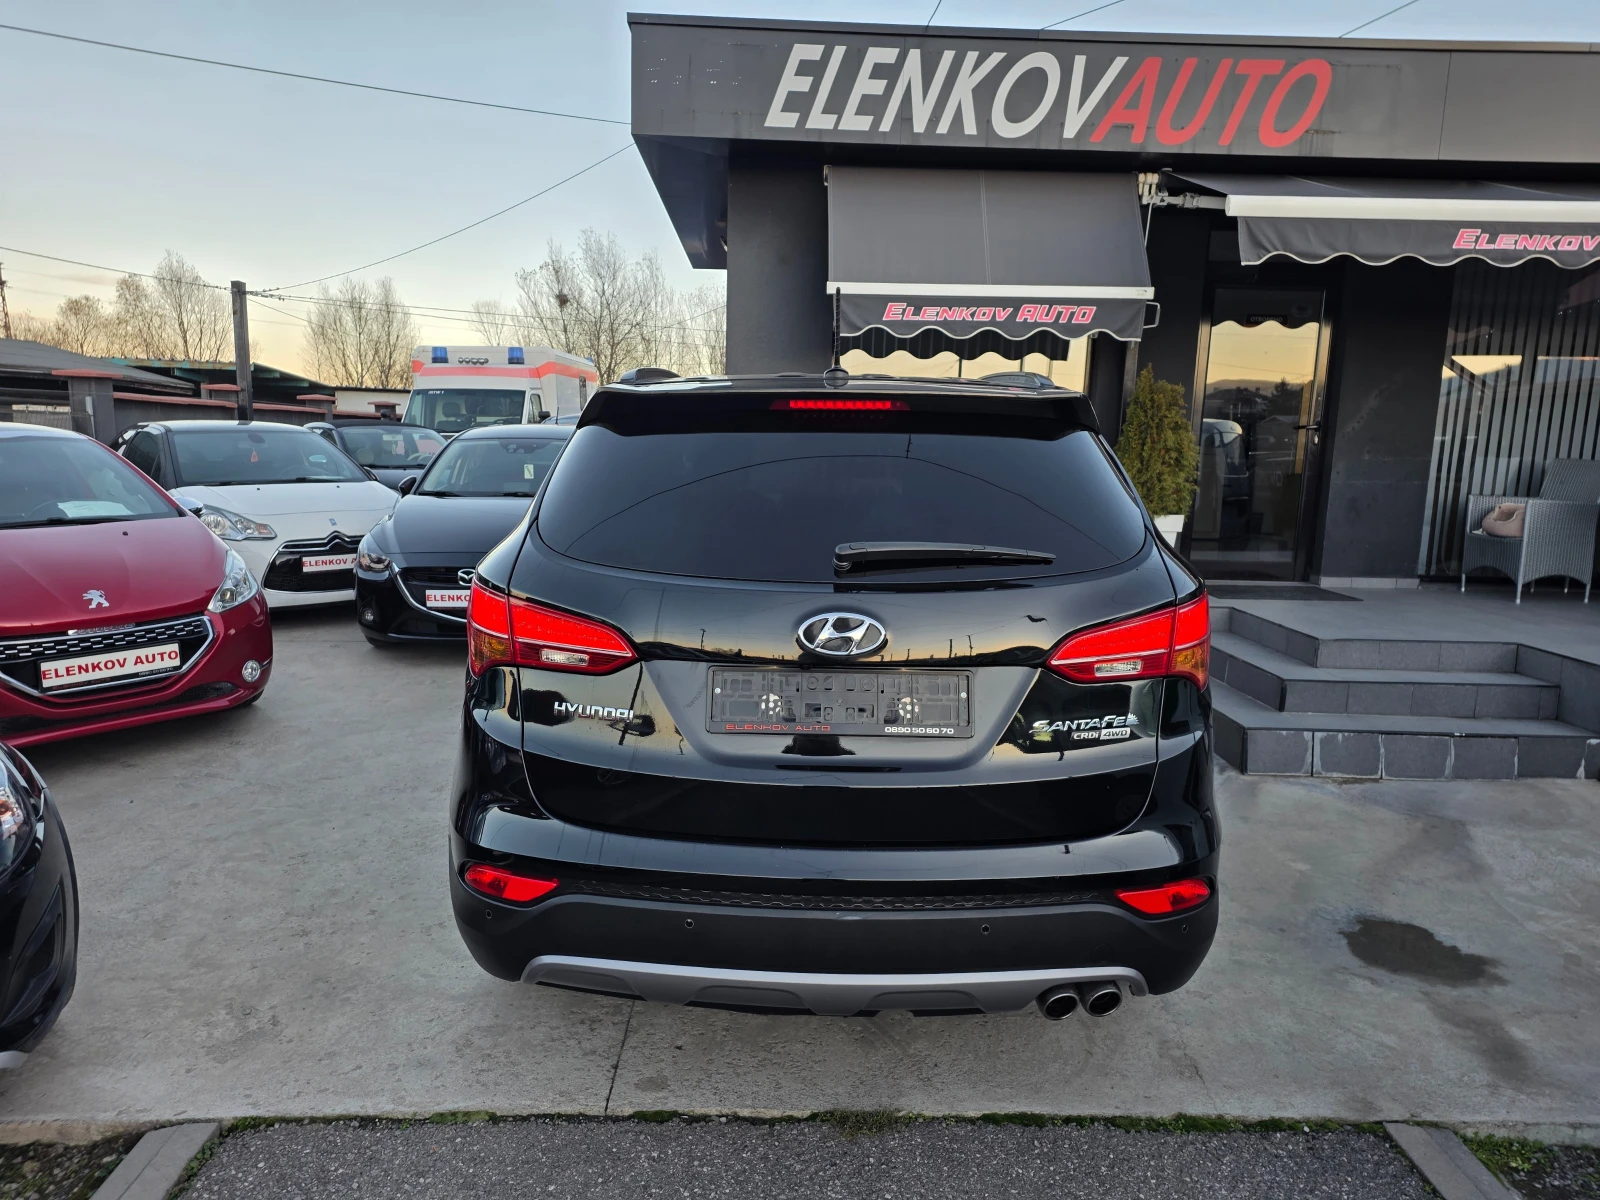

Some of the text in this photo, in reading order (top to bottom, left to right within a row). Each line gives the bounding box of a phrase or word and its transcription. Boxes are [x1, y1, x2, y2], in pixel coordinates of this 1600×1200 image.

[1452, 228, 1600, 252] ELENKOV
[882, 302, 1097, 324] ELENKOV AUTO
[302, 556, 348, 568] ELENKOV
[426, 594, 471, 602] ELENKO
[41, 657, 128, 681] ELENKOV
[133, 650, 179, 667] AUTO
[553, 701, 634, 721] HYUNDAI
[725, 723, 790, 731] ELENKOV
[1073, 729, 1128, 740] CRDi 4WD
